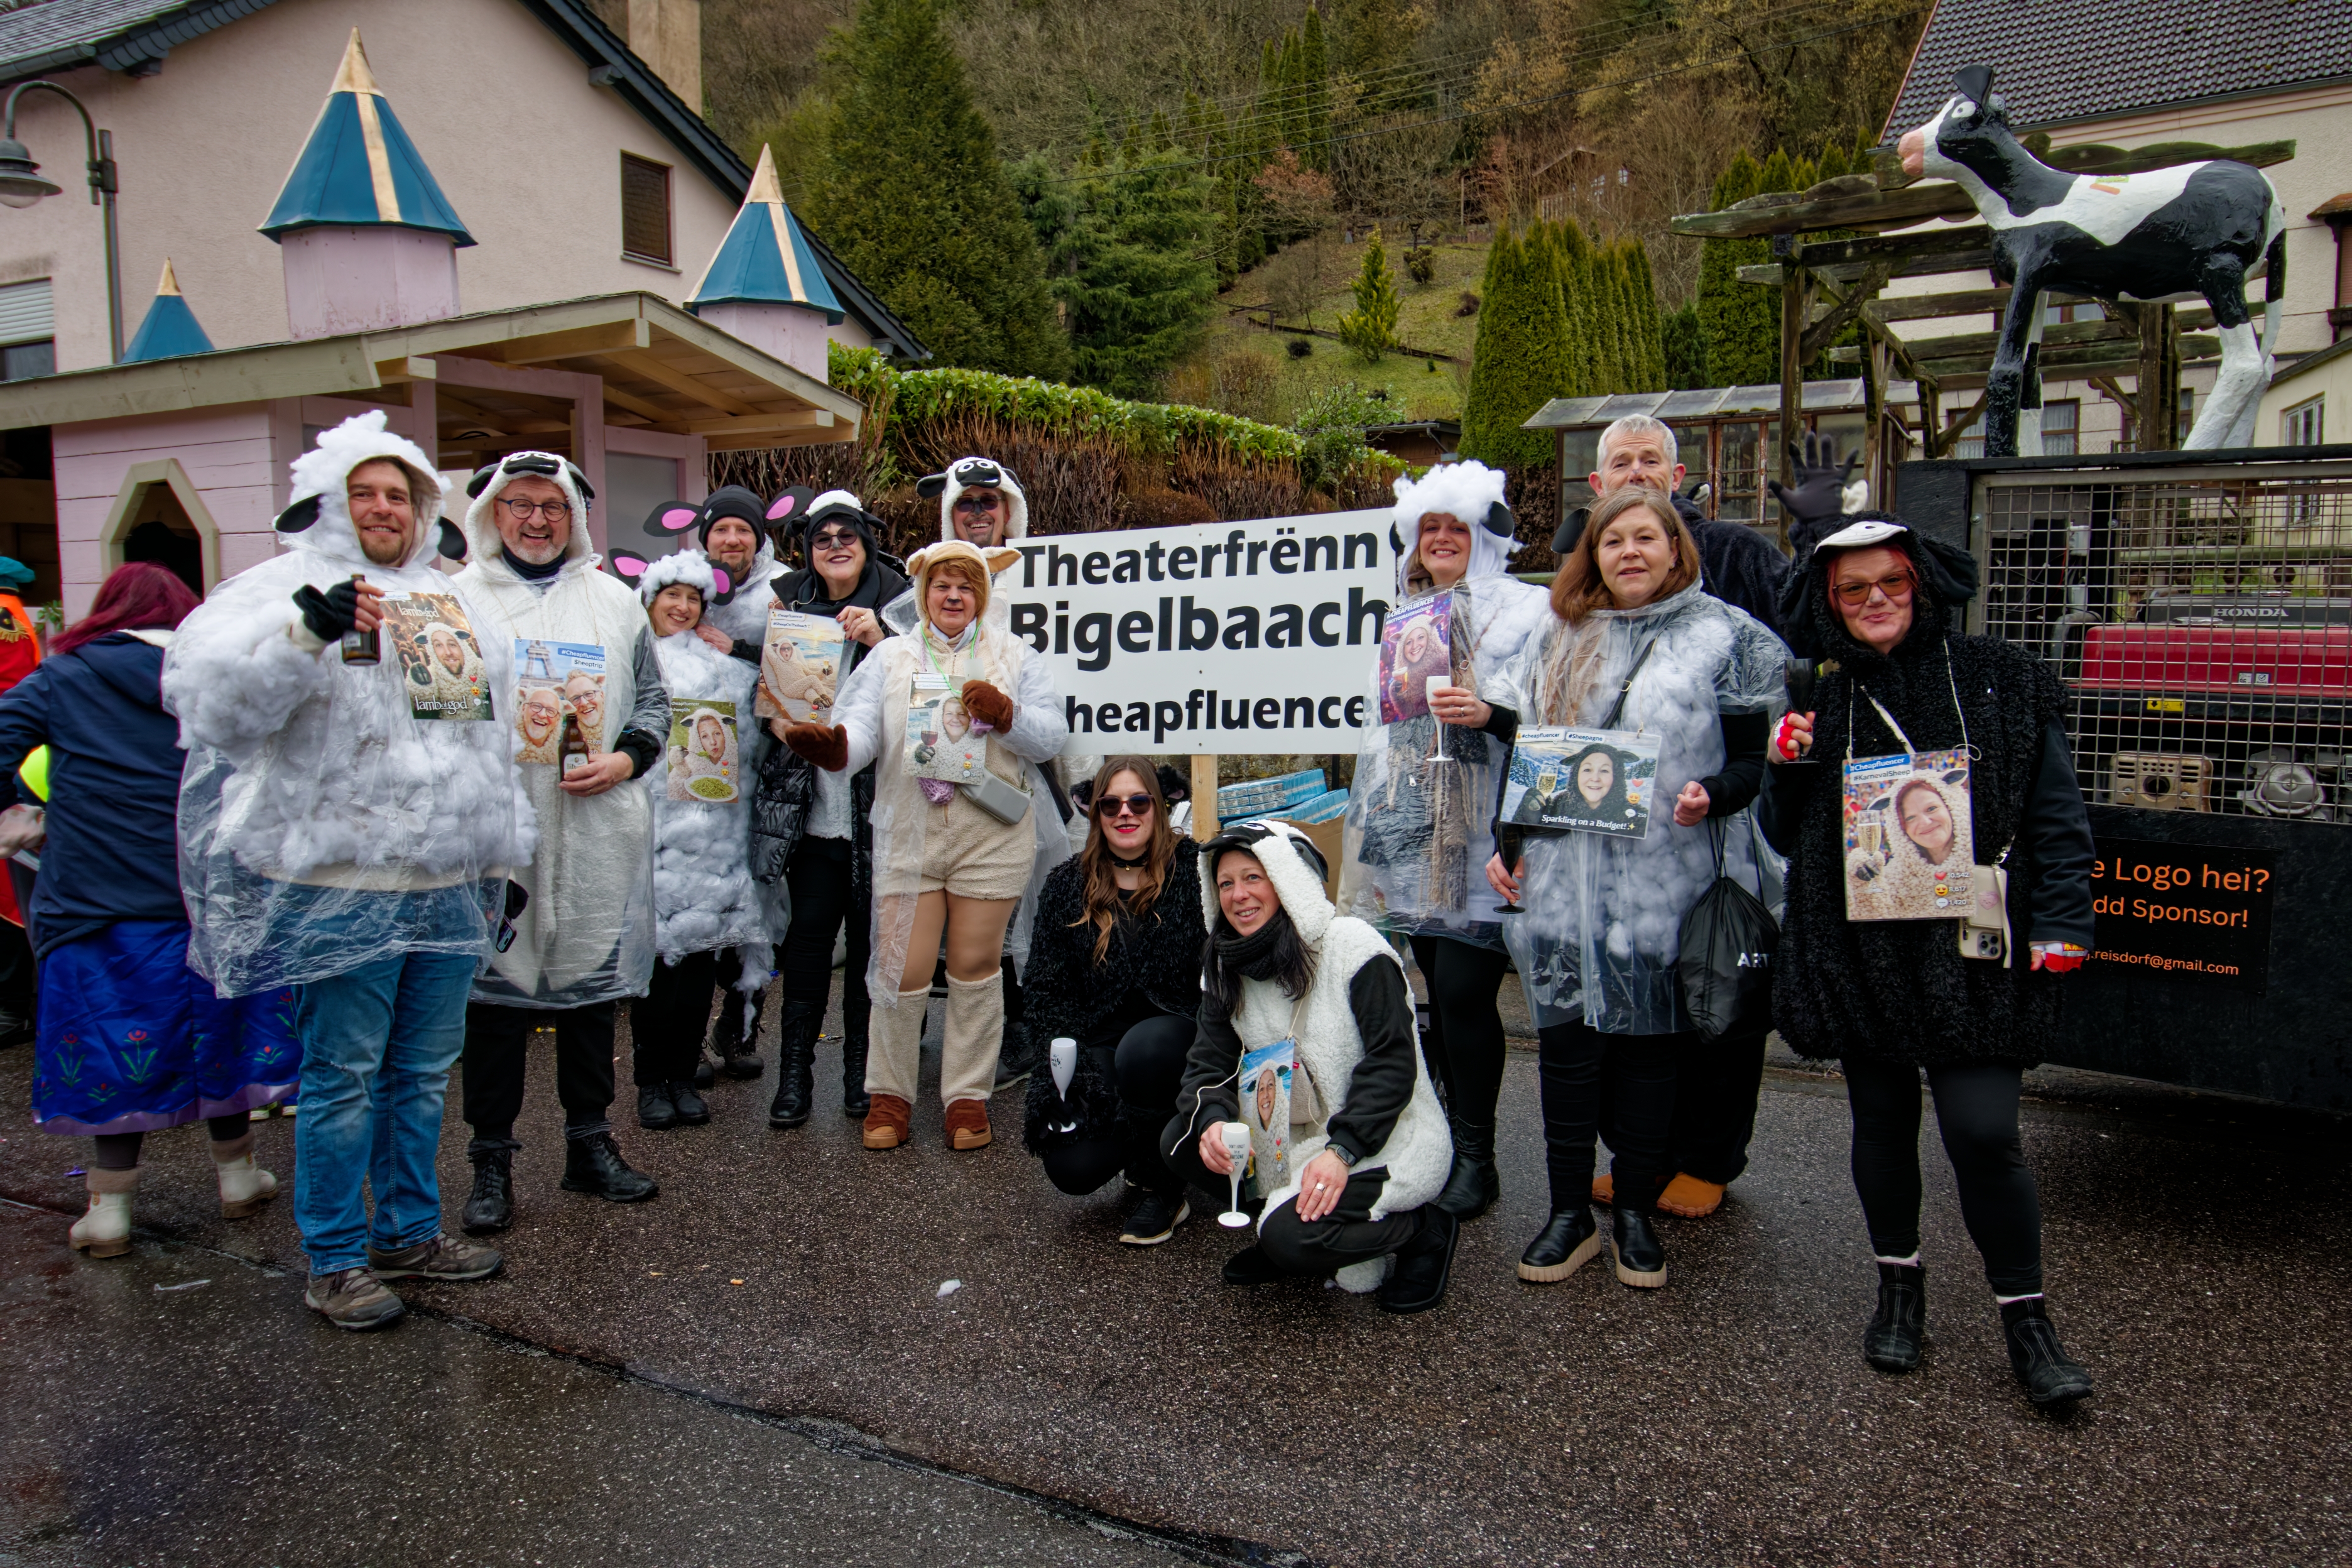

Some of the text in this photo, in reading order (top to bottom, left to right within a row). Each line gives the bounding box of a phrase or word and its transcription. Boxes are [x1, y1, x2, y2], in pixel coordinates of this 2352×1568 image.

[1014, 527, 1378, 588] Theaterfrënn
[396, 602, 422, 616] lamb
[426, 606, 440, 621] god
[2213, 608, 2289, 617] HONDA
[1010, 587, 1388, 672] Bigelbaach
[561, 650, 605, 661] #Cheapfluencer
[574, 659, 603, 668] Sheeptrip
[415, 694, 441, 711] lamb
[448, 695, 468, 714] god
[1568, 734, 1603, 742] #Sheepagne
[1850, 758, 1905, 771] #Cheapfluencer
[1853, 770, 1911, 781] #KarnevalSheep
[1541, 814, 1577, 826] Sparkling
[1596, 820, 1627, 830] Budget!
[2115, 858, 2191, 891] Logo
[2202, 864, 2270, 893] hei?
[2132, 899, 2248, 928] Sponsor!
